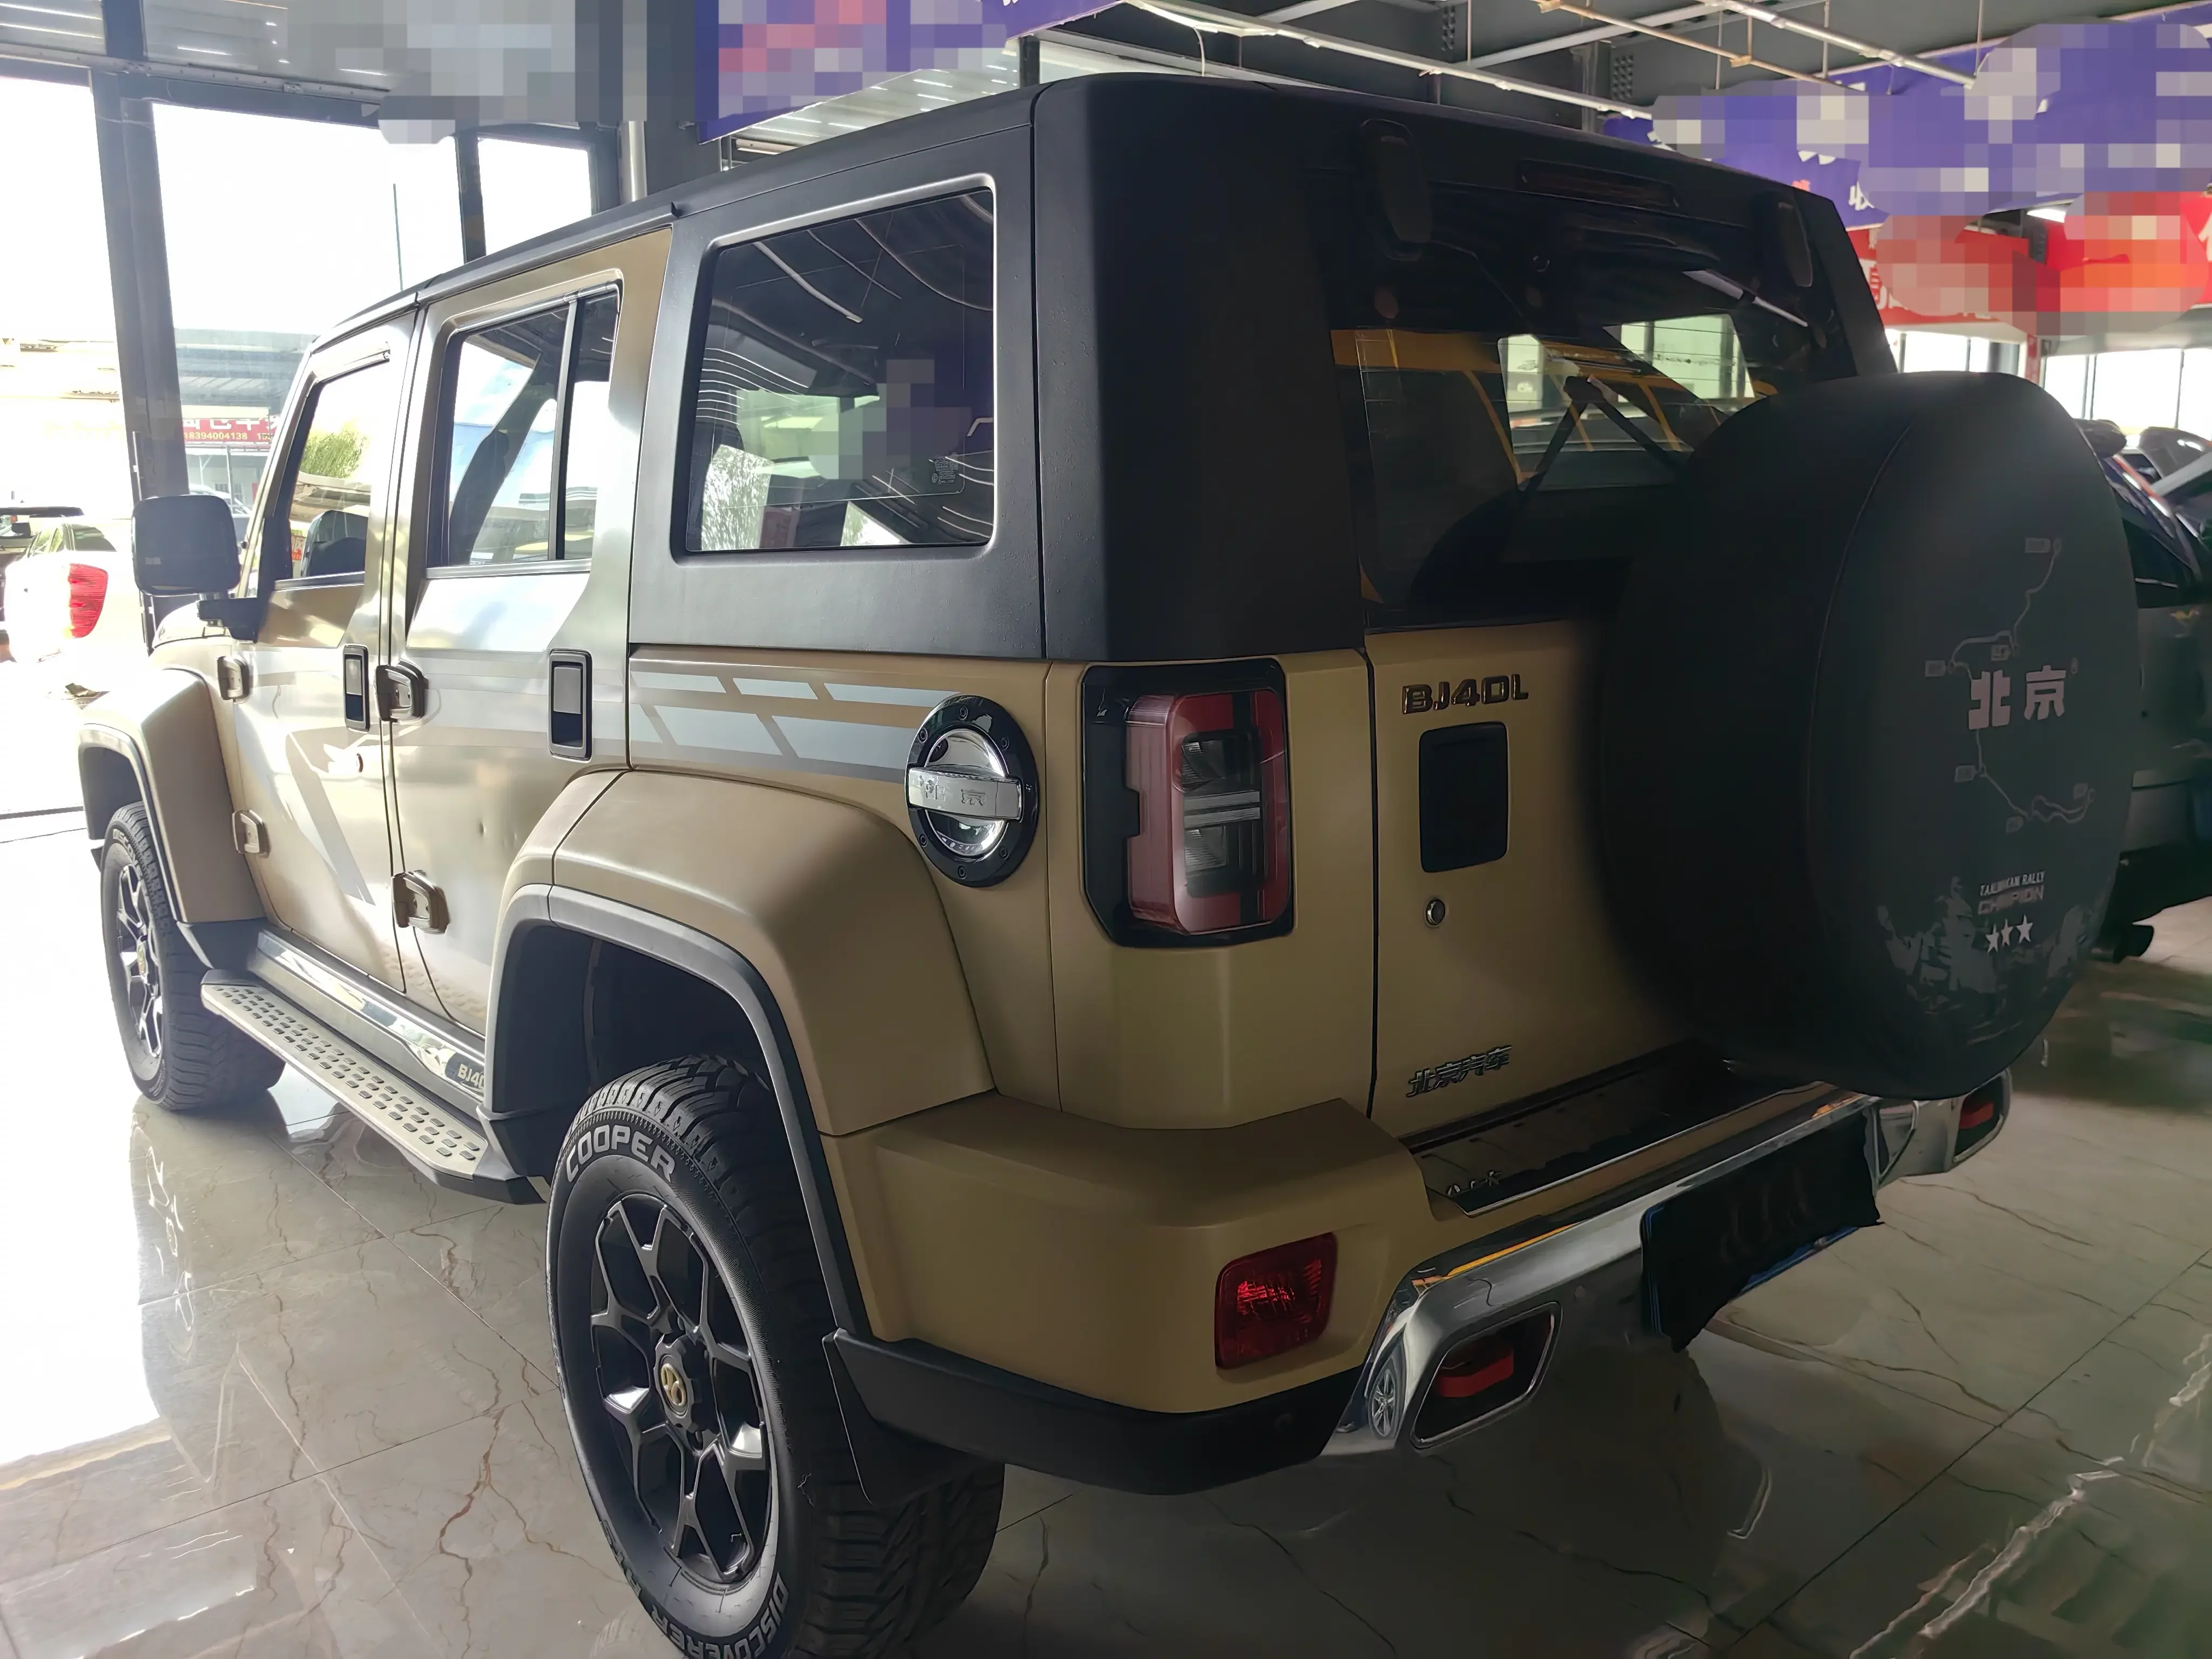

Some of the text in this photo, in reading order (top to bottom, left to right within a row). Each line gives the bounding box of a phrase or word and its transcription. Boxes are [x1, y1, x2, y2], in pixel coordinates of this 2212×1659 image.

[1402, 674, 1529, 714] BJ40L
[1968, 665, 2066, 730] 北京
[2022, 871, 2045, 885] RALLY
[1406, 1045, 1512, 1097] 北京汽车
[567, 1124, 676, 1183] COOPER
